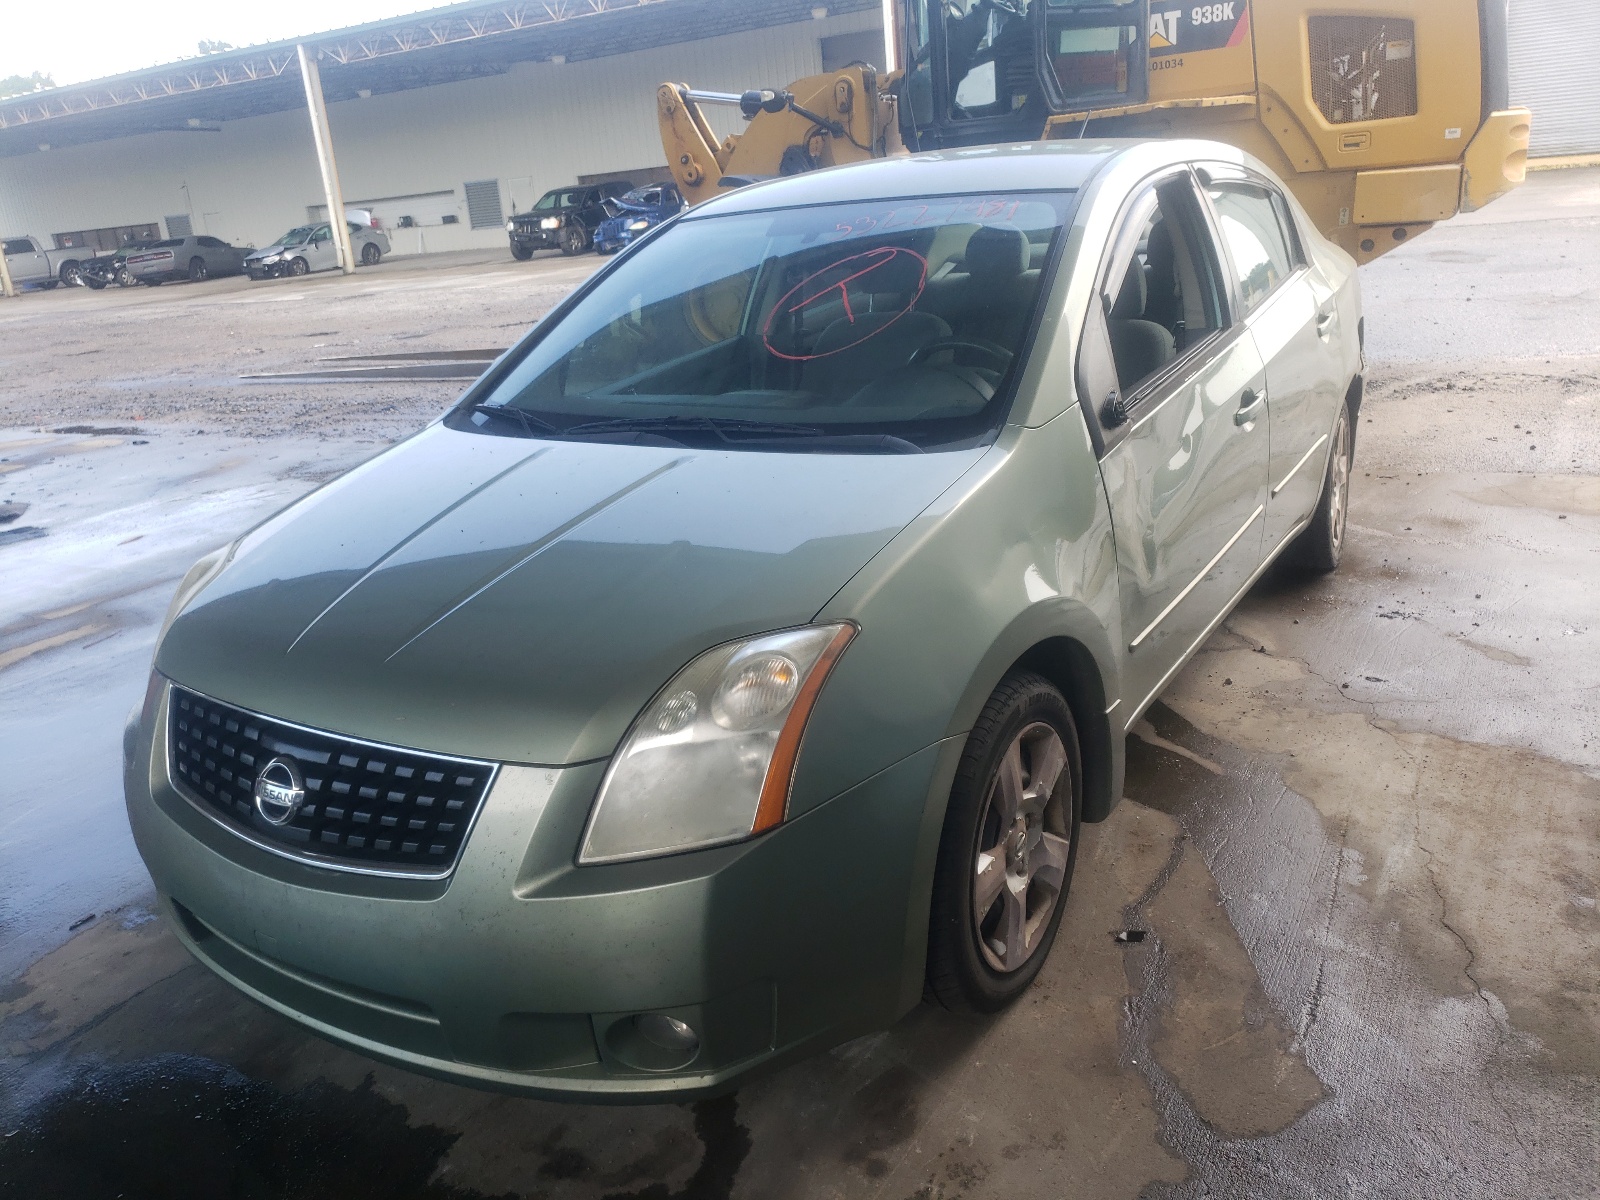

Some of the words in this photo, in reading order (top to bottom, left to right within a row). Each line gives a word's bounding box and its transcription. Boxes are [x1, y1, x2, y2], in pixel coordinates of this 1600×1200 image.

[1150, 10, 1181, 45] AT
[1192, 2, 1234, 25] 938K
[261, 786, 294, 803] SSAN
